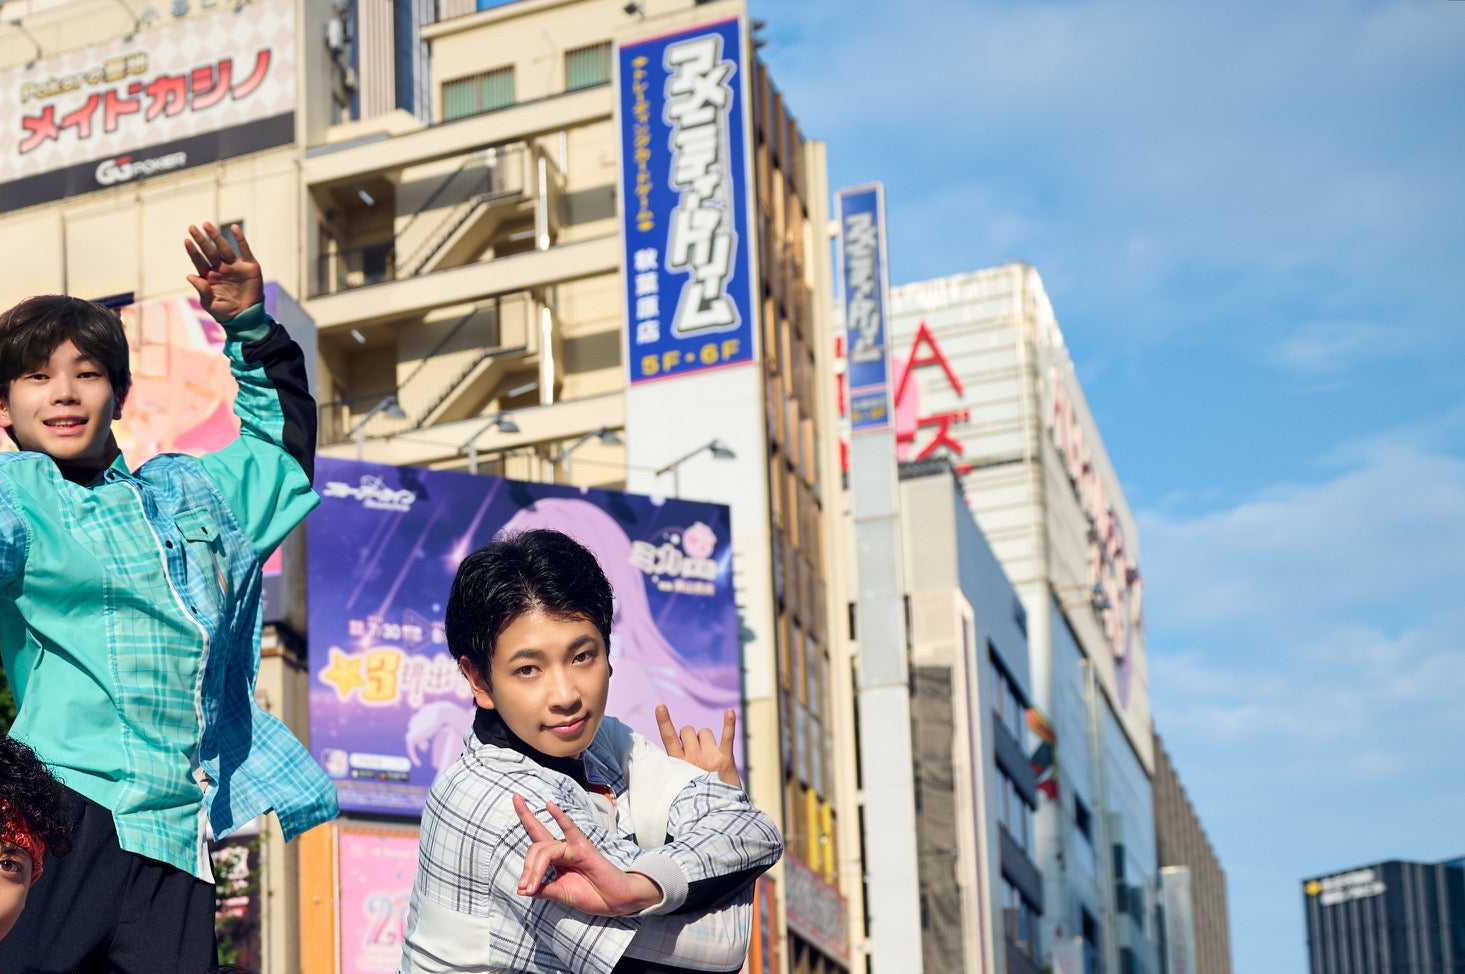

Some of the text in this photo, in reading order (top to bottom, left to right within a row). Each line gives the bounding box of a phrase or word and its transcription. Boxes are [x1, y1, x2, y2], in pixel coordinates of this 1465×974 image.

[19, 50, 272, 154] メイドカジノ
[666, 35, 739, 336] アメニティドリーム
